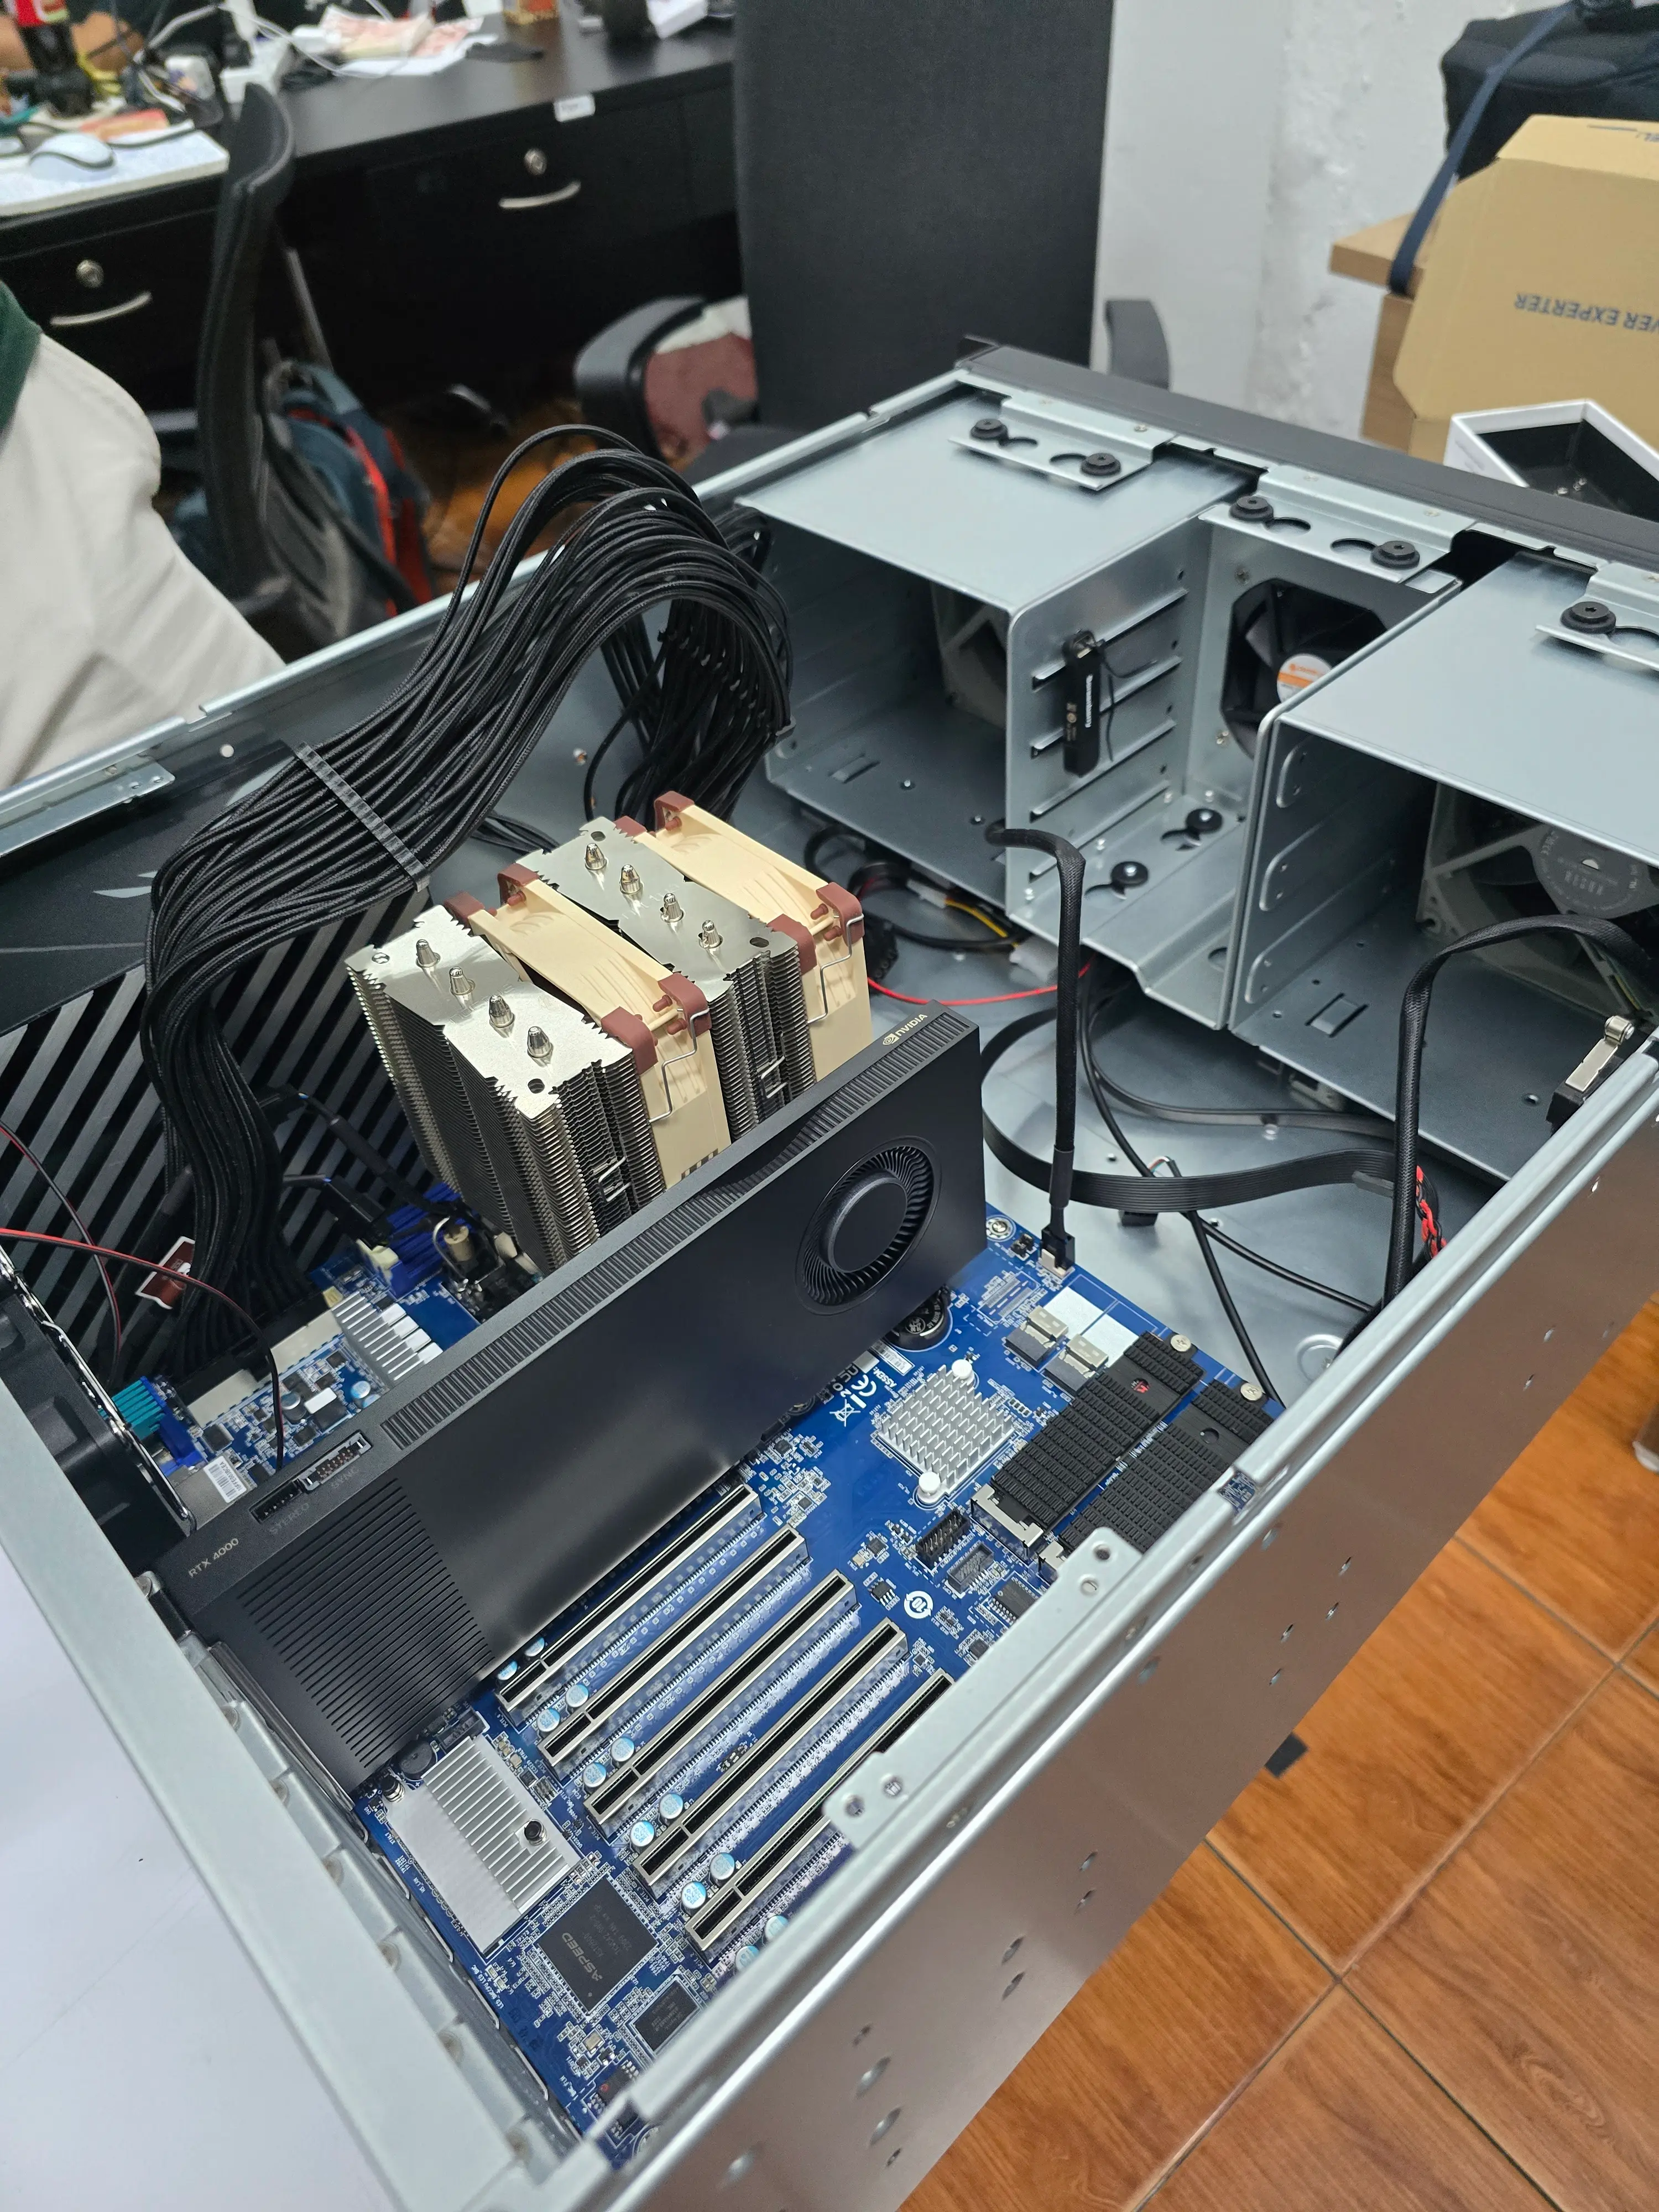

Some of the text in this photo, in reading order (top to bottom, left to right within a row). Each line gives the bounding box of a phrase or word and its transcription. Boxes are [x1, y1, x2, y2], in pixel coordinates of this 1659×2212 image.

[1514, 293, 1619, 327] EXPERTER
[188, 1537, 240, 1579] RTX 4000
[637, 1886, 650, 1901] PCIE_3
[686, 1890, 698, 1900] 270
[561, 1932, 602, 1981] ASPEED
[690, 1952, 704, 1968] PCIE_2
